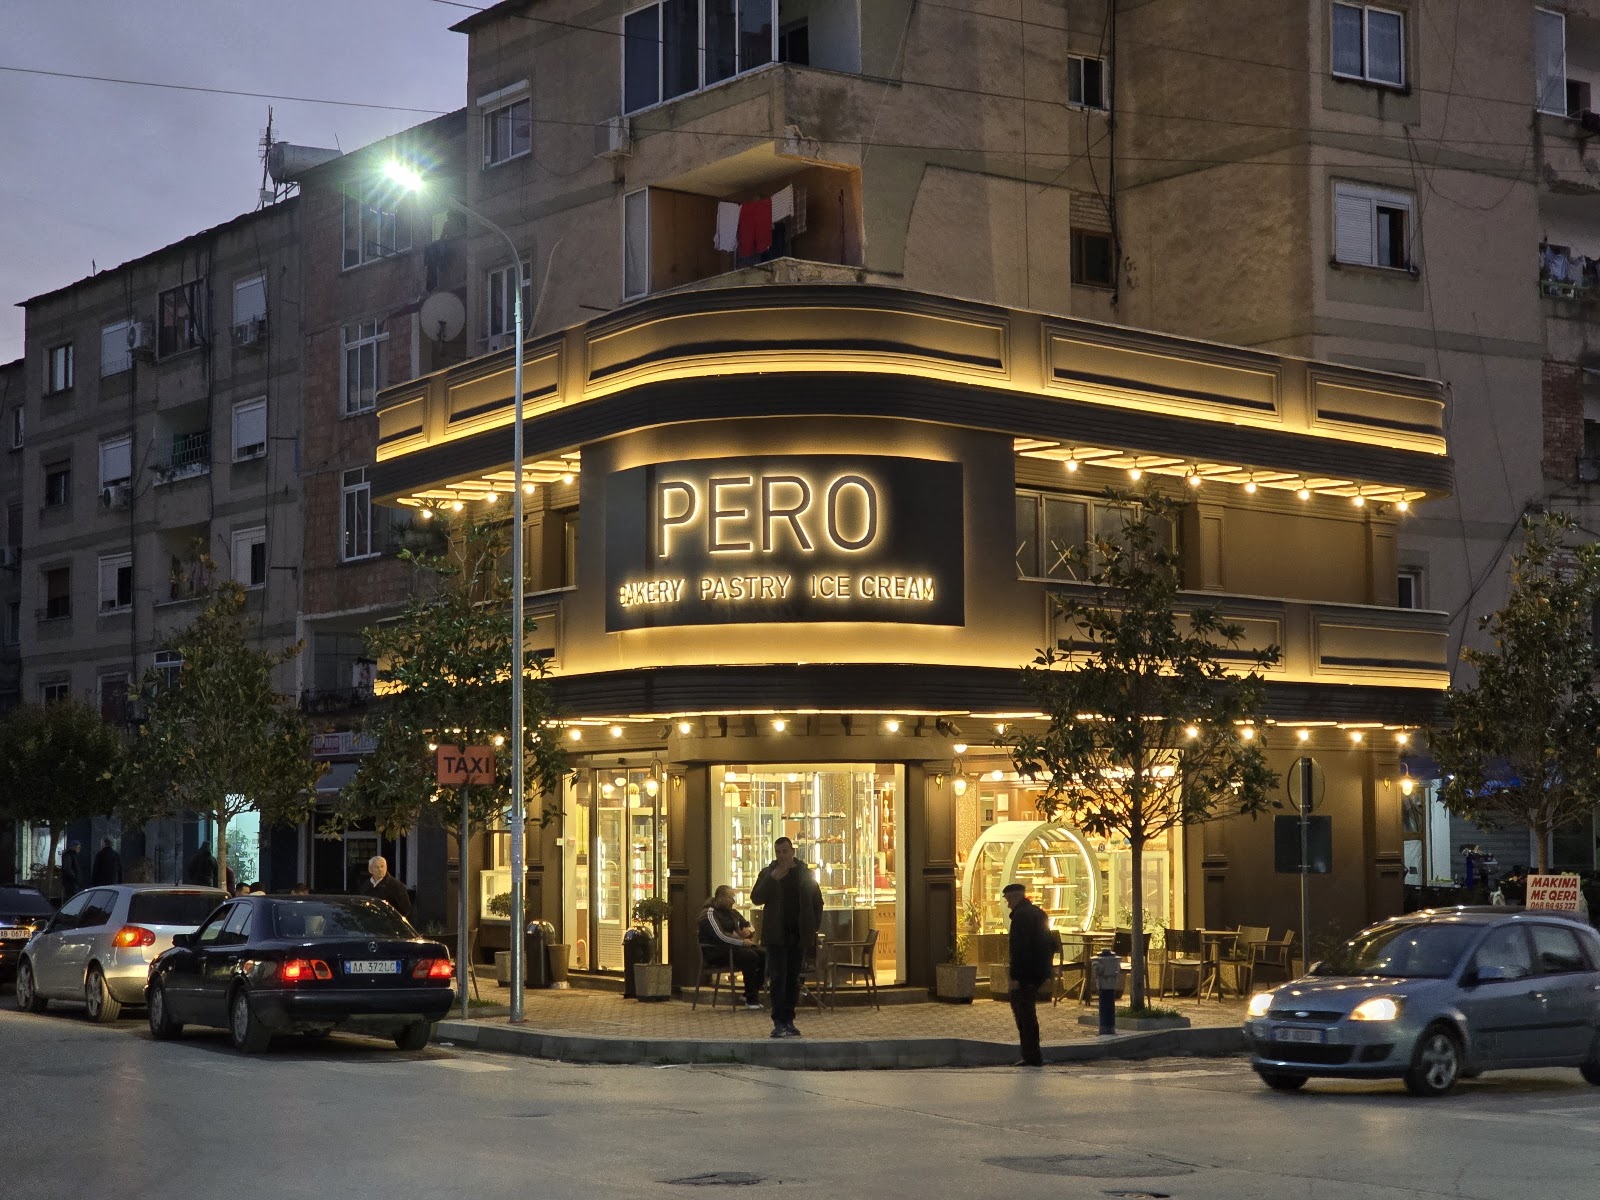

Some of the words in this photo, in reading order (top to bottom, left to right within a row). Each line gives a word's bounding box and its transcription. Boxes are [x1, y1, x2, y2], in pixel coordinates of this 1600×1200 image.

[658, 475, 878, 558] PERO
[619, 578, 686, 607] BAKERY
[701, 574, 792, 601] PASTRY
[811, 574, 851, 600] ICE
[859, 575, 936, 602] CREAM
[443, 756, 490, 774] TAXI
[1531, 877, 1577, 888] MAKINA
[1531, 890, 1547, 901] ME
[1549, 890, 1577, 902] QERA
[352, 962, 364, 972] AA
